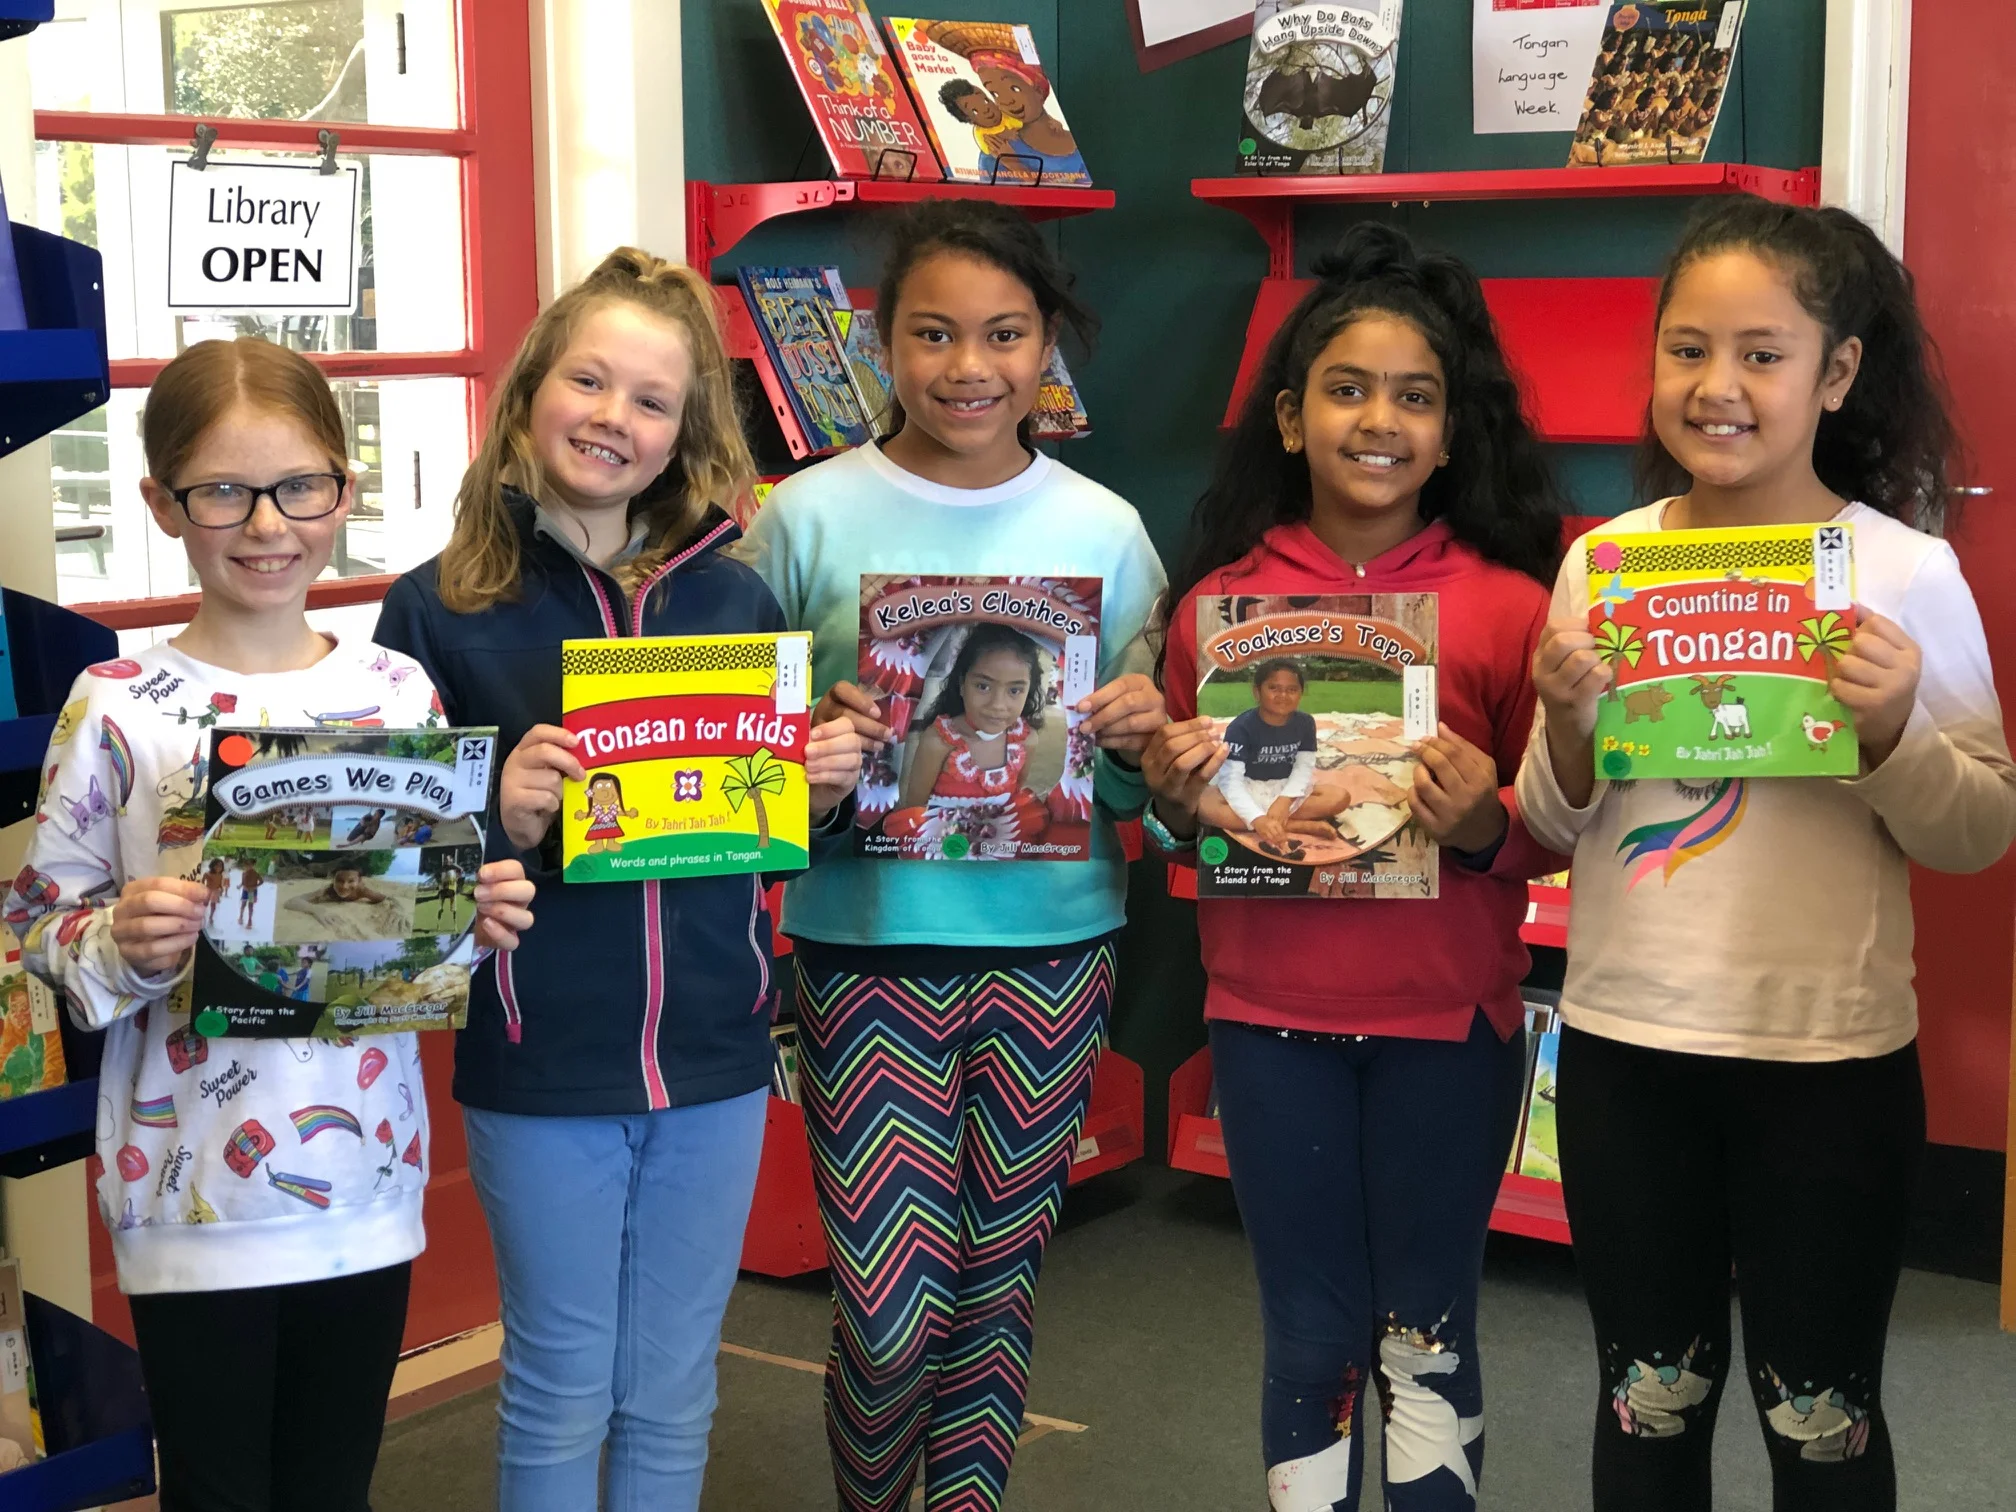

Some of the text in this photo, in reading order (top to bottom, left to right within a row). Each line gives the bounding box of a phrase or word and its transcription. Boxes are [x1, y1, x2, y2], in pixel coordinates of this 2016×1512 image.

[1278, 13, 1311, 28] Why
[1317, 10, 1336, 23] Do
[1341, 10, 1374, 31] Bats
[1665, 9, 1708, 24] Tonga
[906, 41, 936, 53] Baby
[1262, 24, 1383, 53] Hang Upside Down?
[1513, 34, 1568, 57] Tongan
[911, 54, 949, 62] goes to
[914, 62, 958, 75] Market
[1498, 68, 1568, 90] Language
[817, 94, 892, 120] Think of a
[1514, 100, 1560, 115] Week.
[828, 117, 923, 147] NUMBER
[1031, 171, 1087, 179] BOOKSBANK
[208, 185, 320, 238] Library
[202, 247, 322, 282] OPEN
[764, 277, 782, 289] ROLF
[877, 591, 1083, 635] Kelea's Clothes
[1648, 589, 1790, 619] Counting in
[1216, 618, 1415, 666] Toakase's Tapa
[1647, 628, 1794, 667] Tongan
[129, 668, 171, 699] Sweet
[576, 712, 797, 757] Tongan for Kids
[232, 772, 329, 806] Games
[346, 767, 391, 789] We
[645, 818, 660, 829] By
[662, 817, 687, 830] Jahri
[689, 817, 706, 830] Jah
[864, 844, 900, 853] Kingdom
[903, 844, 912, 852] of
[875, 836, 900, 844] Story
[980, 842, 1081, 854] By Jill MacGregor
[610, 850, 763, 868] Words and phrases in Tongan.
[1213, 866, 1292, 876] A Story from the
[1215, 876, 1290, 885] Islands of Tonga
[1319, 872, 1423, 884] By Jill MacGregor
[215, 1005, 245, 1016] Story
[249, 1006, 274, 1015] from
[278, 1007, 295, 1016] the
[231, 1015, 266, 1025] Pacific
[334, 1002, 448, 1019] By Jill MacGregor
[200, 1059, 241, 1099] Sweet
[215, 1068, 257, 1108] Power
[166, 1145, 192, 1194] Sweet
